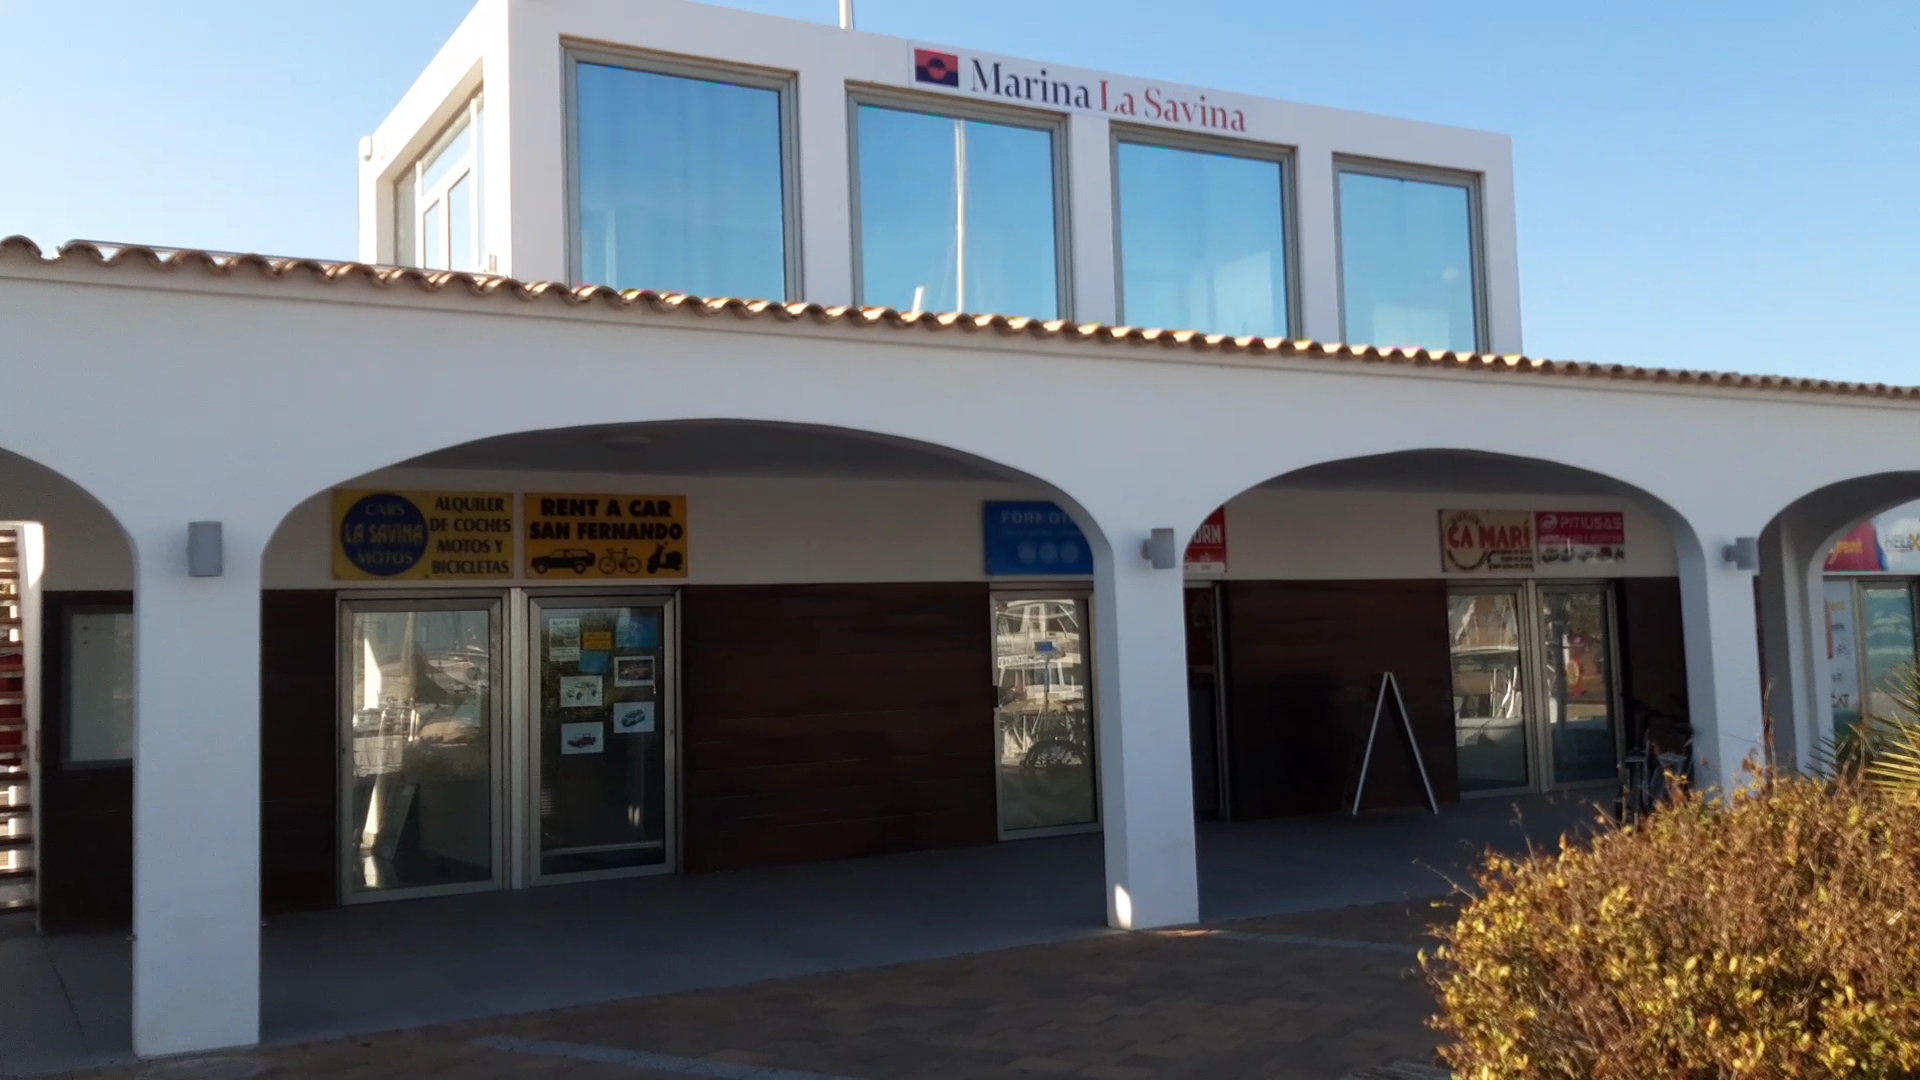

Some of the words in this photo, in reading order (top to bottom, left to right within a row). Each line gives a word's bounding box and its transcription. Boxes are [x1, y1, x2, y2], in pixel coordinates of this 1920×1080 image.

[970, 58, 1092, 109] Marina
[1099, 80, 1137, 116] La
[1144, 87, 1246, 132] Savina
[365, 503, 405, 516] CARS
[434, 497, 504, 513] ALQUILER
[541, 498, 597, 517] RENT
[605, 499, 623, 517] A
[629, 500, 672, 518] CAR
[430, 518, 450, 531] DE
[454, 519, 512, 532] COCHES
[1560, 516, 1622, 530] PITIUSAS
[345, 523, 364, 543] LA
[369, 523, 423, 544] SAVINA
[529, 522, 571, 540] SAN
[577, 522, 684, 541] FERNANDO
[1447, 525, 1473, 549] CA
[1478, 519, 1531, 549] MARÍ
[437, 539, 491, 553] MOTOS
[495, 539, 504, 553] Y
[358, 551, 414, 564] MOTOS
[432, 560, 510, 575] BICICLETAS
